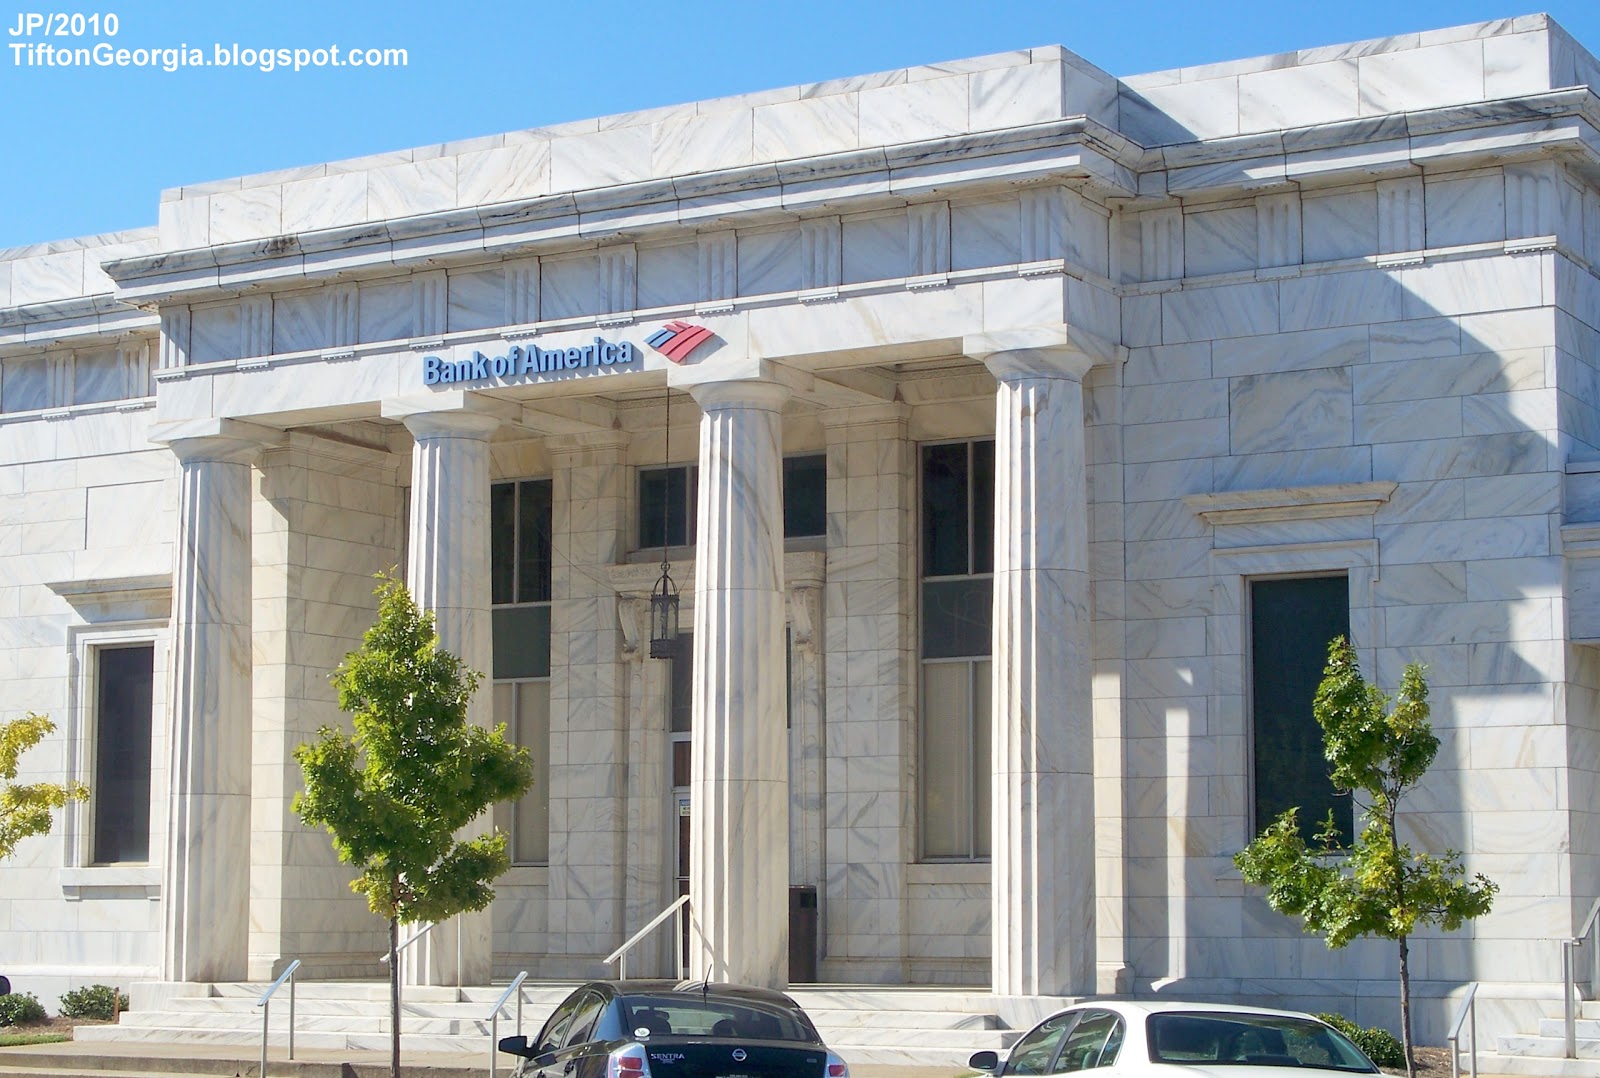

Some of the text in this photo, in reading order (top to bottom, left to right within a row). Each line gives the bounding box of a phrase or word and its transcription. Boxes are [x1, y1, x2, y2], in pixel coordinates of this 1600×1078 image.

[423, 336, 633, 385] Bank of America
